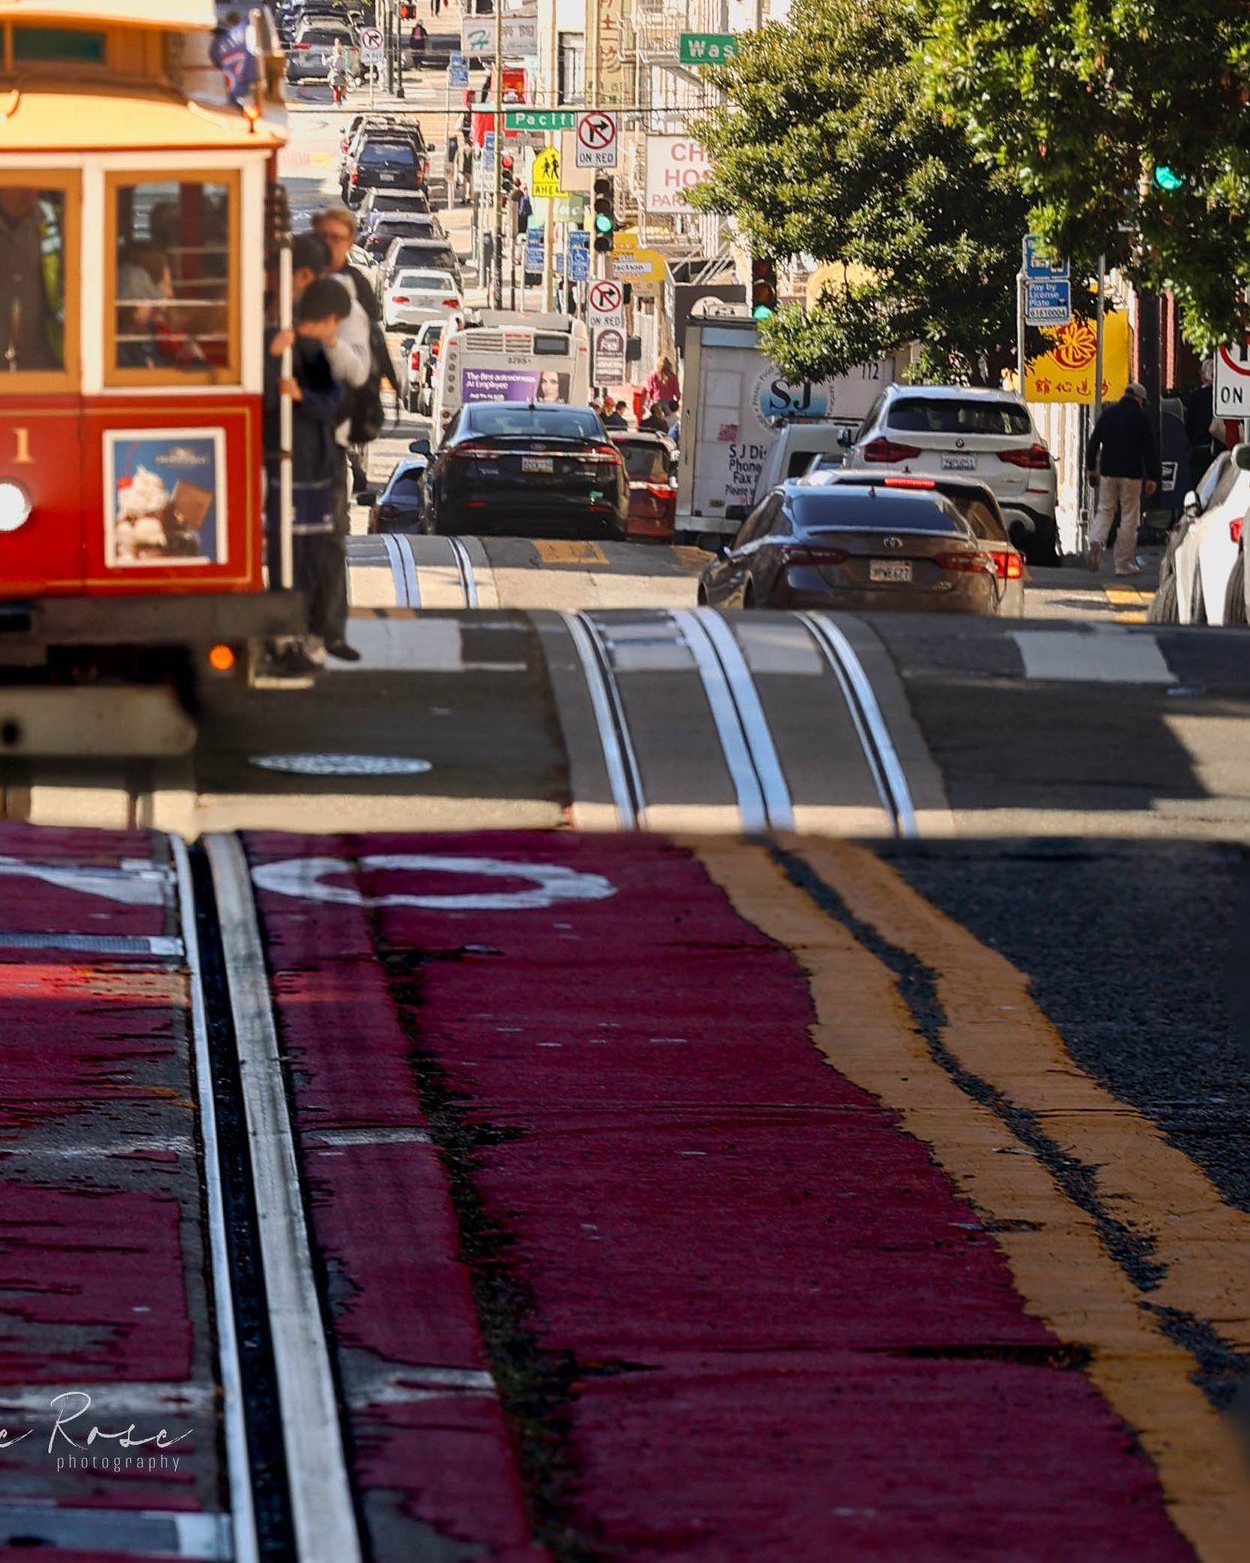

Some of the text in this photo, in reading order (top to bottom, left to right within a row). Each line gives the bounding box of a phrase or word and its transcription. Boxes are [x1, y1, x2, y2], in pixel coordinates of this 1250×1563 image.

[687, 39, 736, 59] Was
[515, 112, 574, 126] Pacifi
[579, 153, 614, 164] ON RED
[1030, 282, 1056, 292] Pay by
[1030, 290, 1060, 299] License
[1030, 298, 1050, 307] Plate
[590, 315, 620, 326] ON RED
[466, 371, 536, 383] The first autonomous
[475, 381, 509, 390] Employee
[769, 378, 812, 410] SJ
[1220, 386, 1243, 405] ON
[729, 458, 762, 472] Phone
[733, 471, 751, 484] Fax
